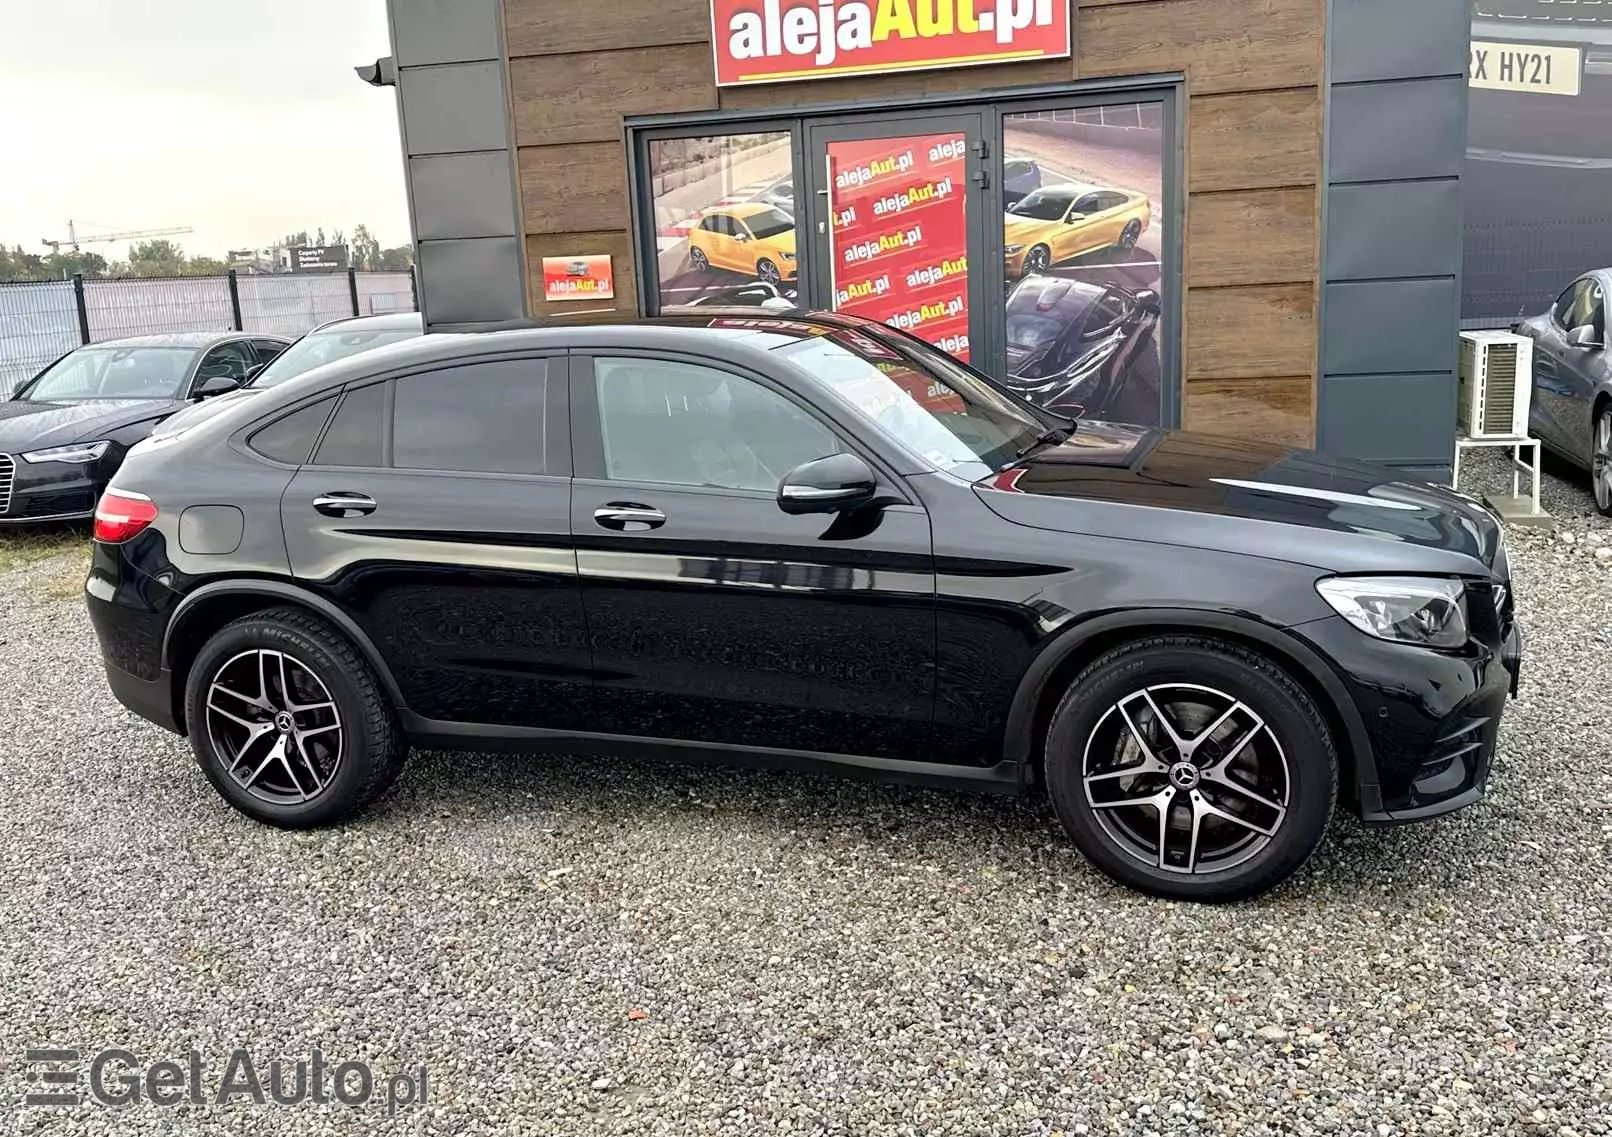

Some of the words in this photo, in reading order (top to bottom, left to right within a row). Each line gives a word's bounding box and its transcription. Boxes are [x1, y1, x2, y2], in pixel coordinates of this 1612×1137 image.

[1468, 50, 1488, 80] X
[1500, 52, 1552, 84] HY21
[929, 140, 966, 162] aleja
[835, 151, 913, 188] alejaAut.pl
[873, 177, 952, 215] alejaAut.pl
[844, 226, 922, 262] alejaAut.pl
[549, 279, 609, 293] alejaAut.pl
[906, 256, 967, 286] alejaAut
